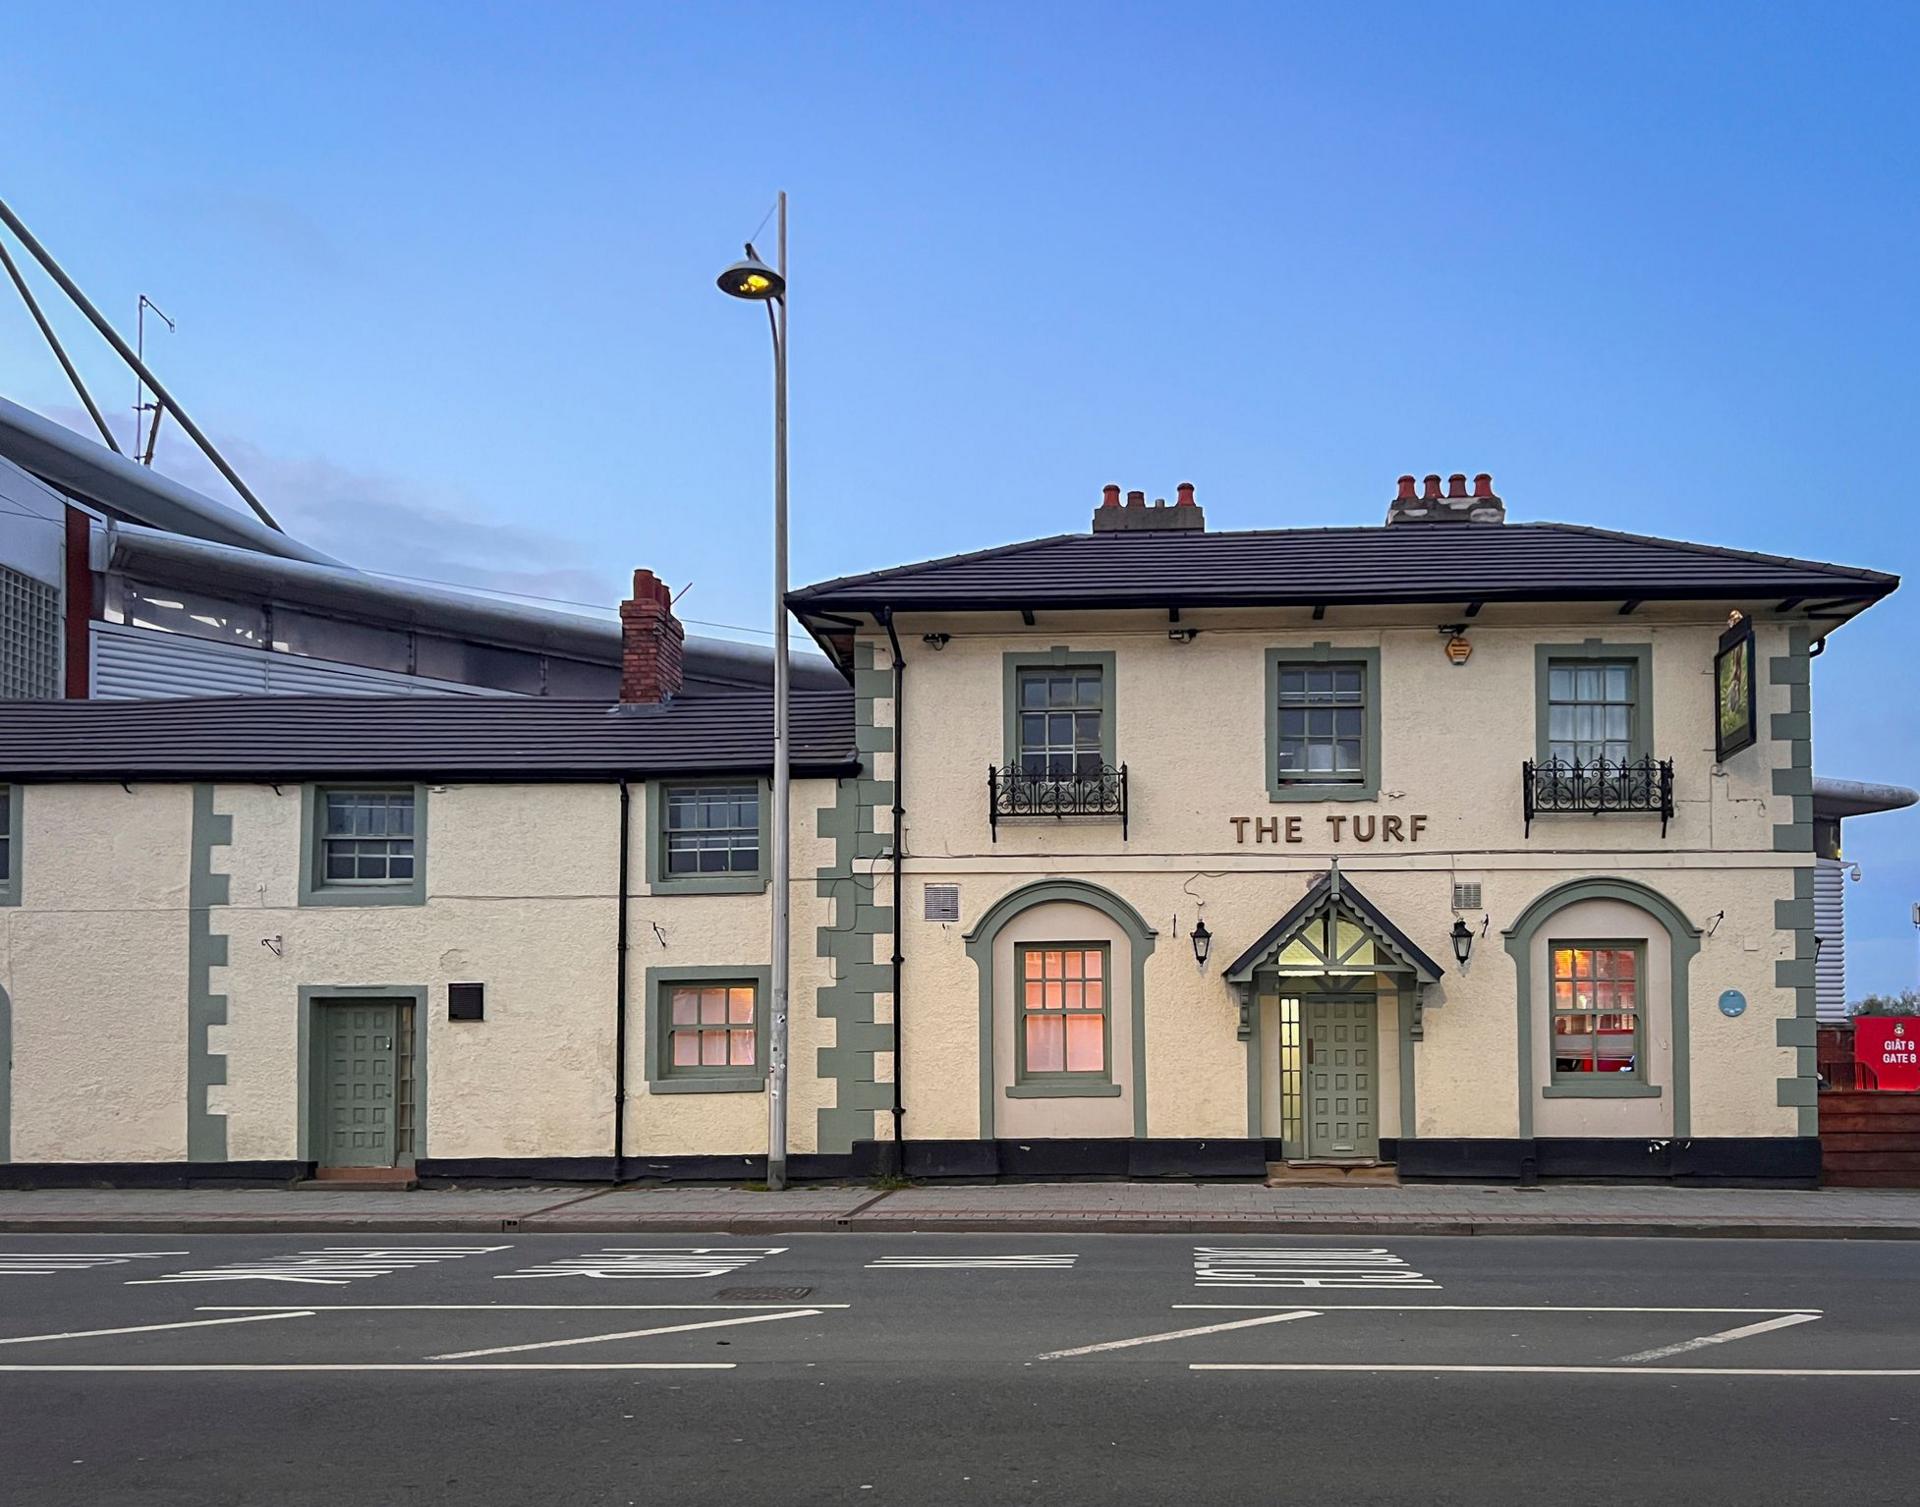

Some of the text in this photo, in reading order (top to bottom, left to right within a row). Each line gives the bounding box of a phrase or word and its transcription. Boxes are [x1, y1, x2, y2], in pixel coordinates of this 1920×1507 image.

[1230, 815, 1428, 844] THE TURF
[1882, 1053, 1917, 1064] GATE 8
[1908, 1040, 1915, 1050] 8
[123, 1245, 514, 1284] THANK
[493, 1246, 789, 1279] FAWR
[864, 1253, 1079, 1269] YN
[1193, 1247, 1443, 1289] DIOLCH
